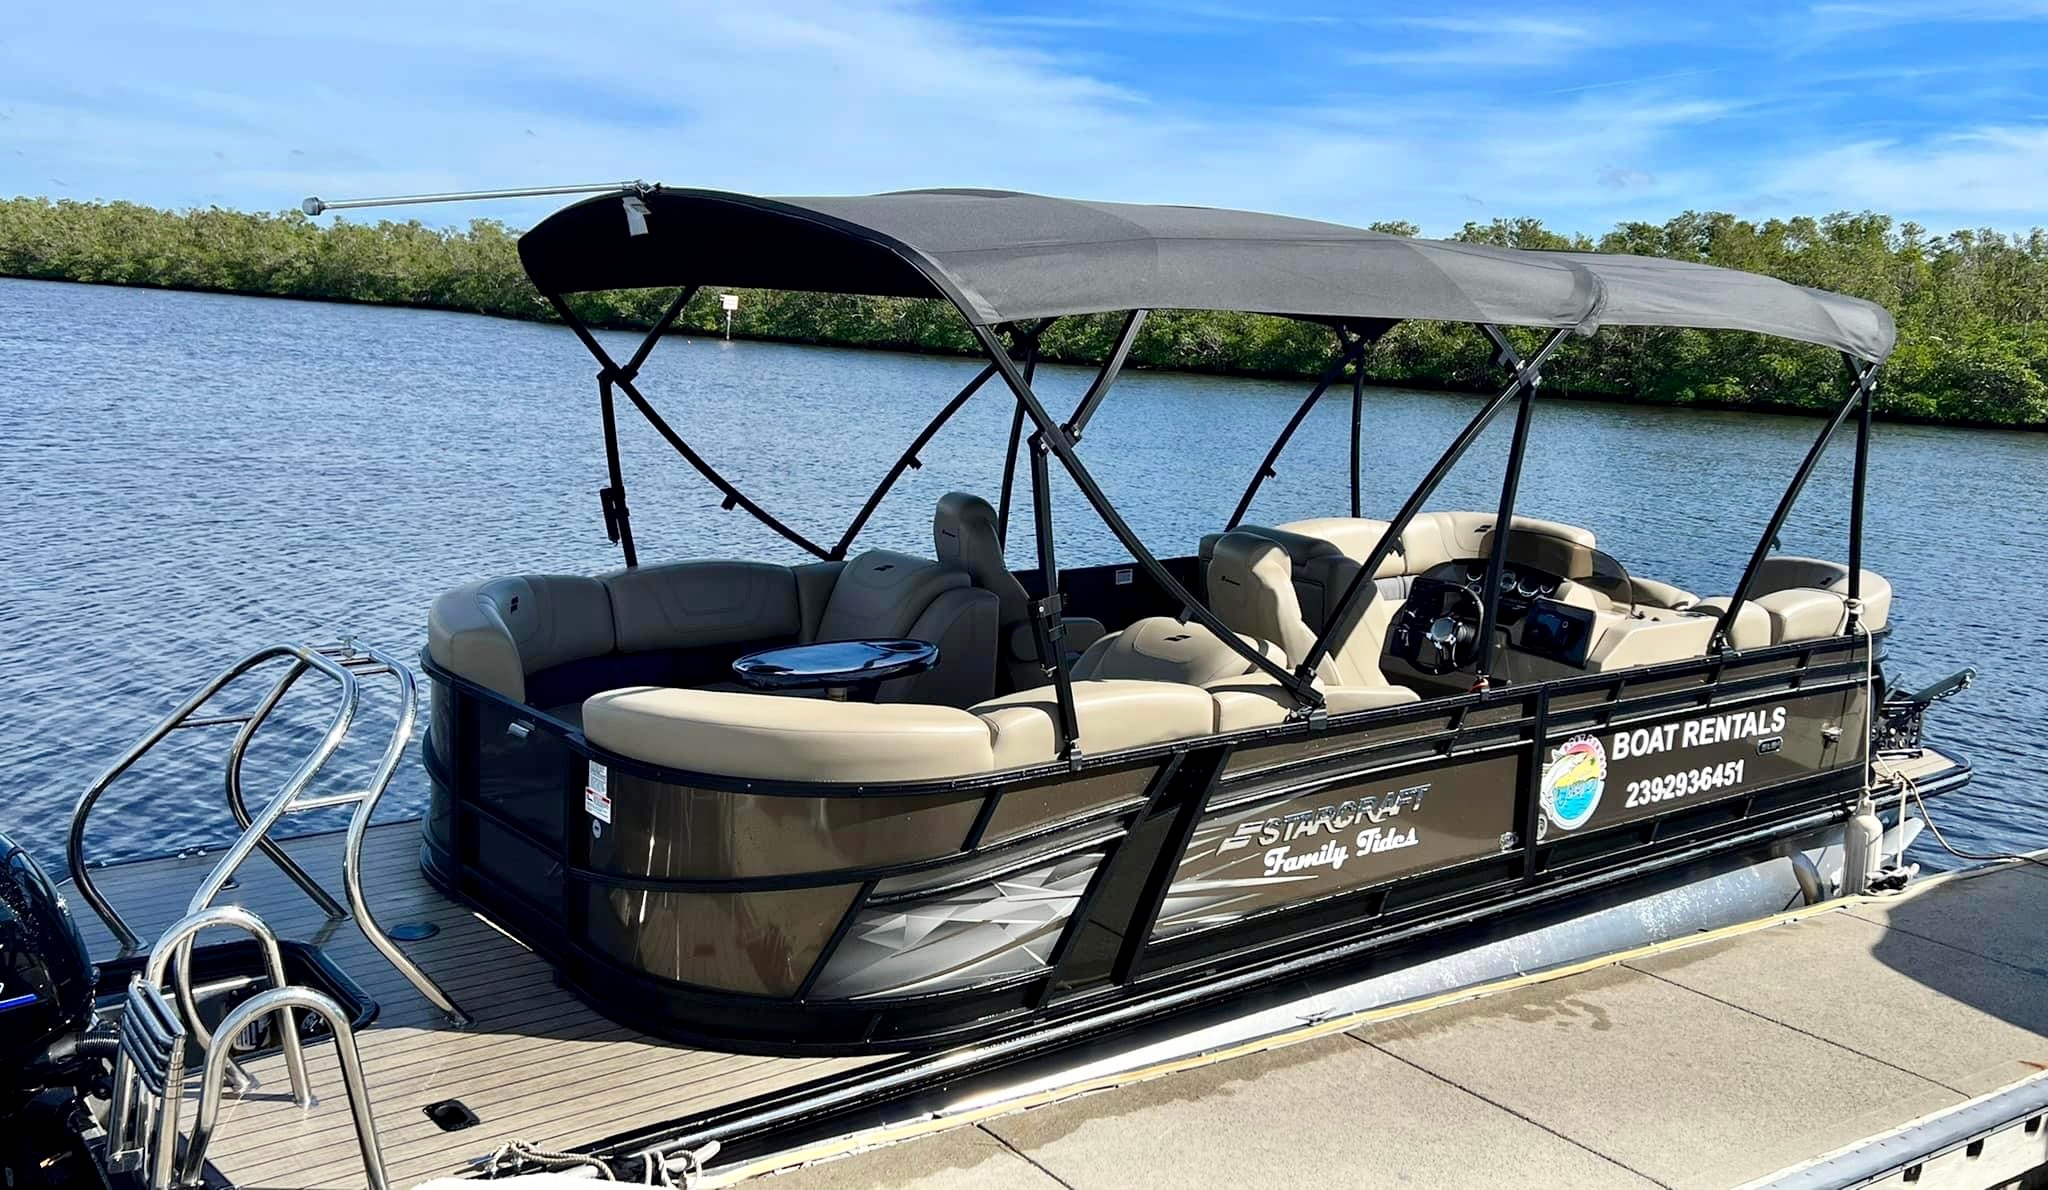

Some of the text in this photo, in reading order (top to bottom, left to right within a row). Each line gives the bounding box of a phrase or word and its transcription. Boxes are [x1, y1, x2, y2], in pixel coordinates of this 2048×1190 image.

[1611, 723, 1679, 761] BOAT
[1682, 706, 1786, 748] RENTALS
[1257, 784, 1431, 846] STARCRAFT
[1264, 827, 1419, 876] Family Tides
